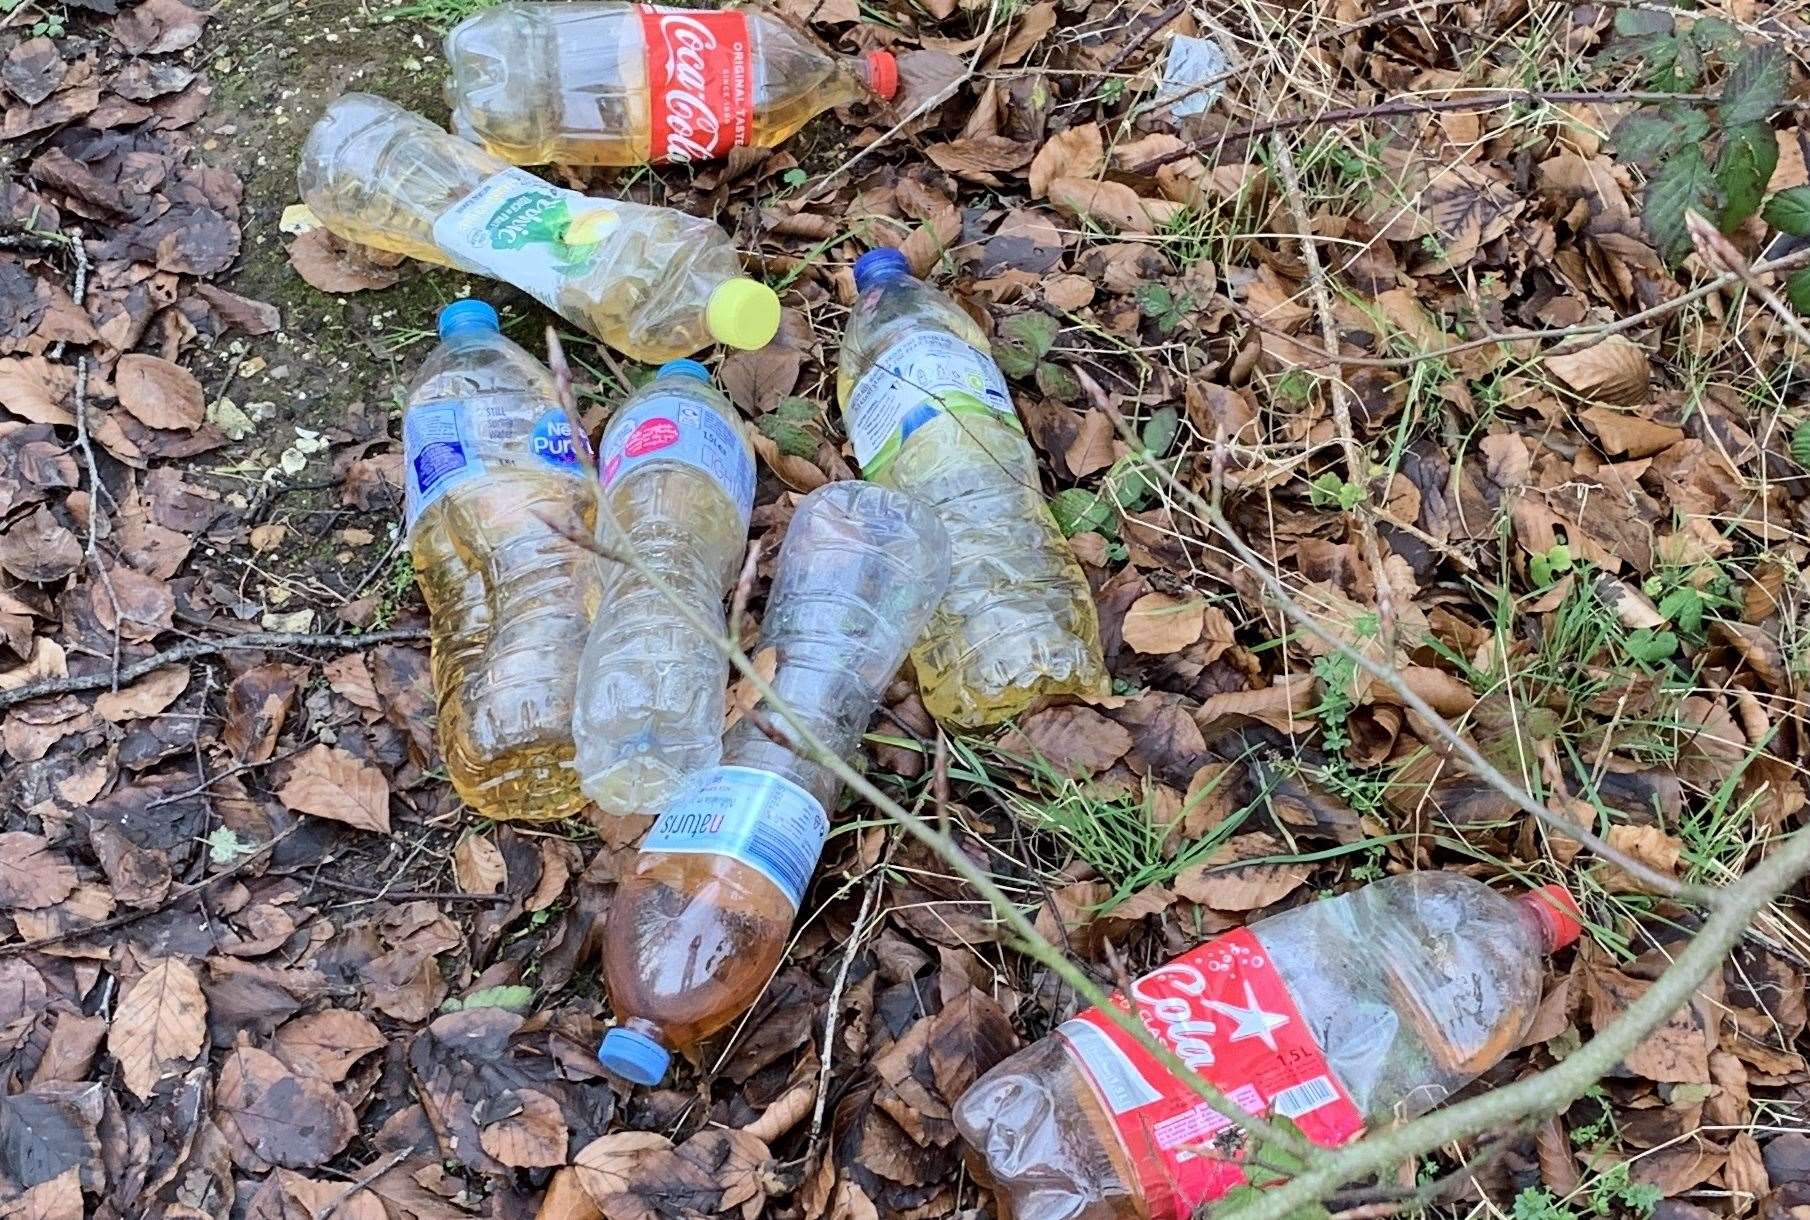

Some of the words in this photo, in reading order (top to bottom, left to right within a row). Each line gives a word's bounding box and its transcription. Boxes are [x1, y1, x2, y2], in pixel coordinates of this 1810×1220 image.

[732, 42, 745, 107] ORIGINAL
[732, 110, 746, 147] TASTE
[660, 813, 725, 840] naturis
[1131, 963, 1216, 1073] Cola
